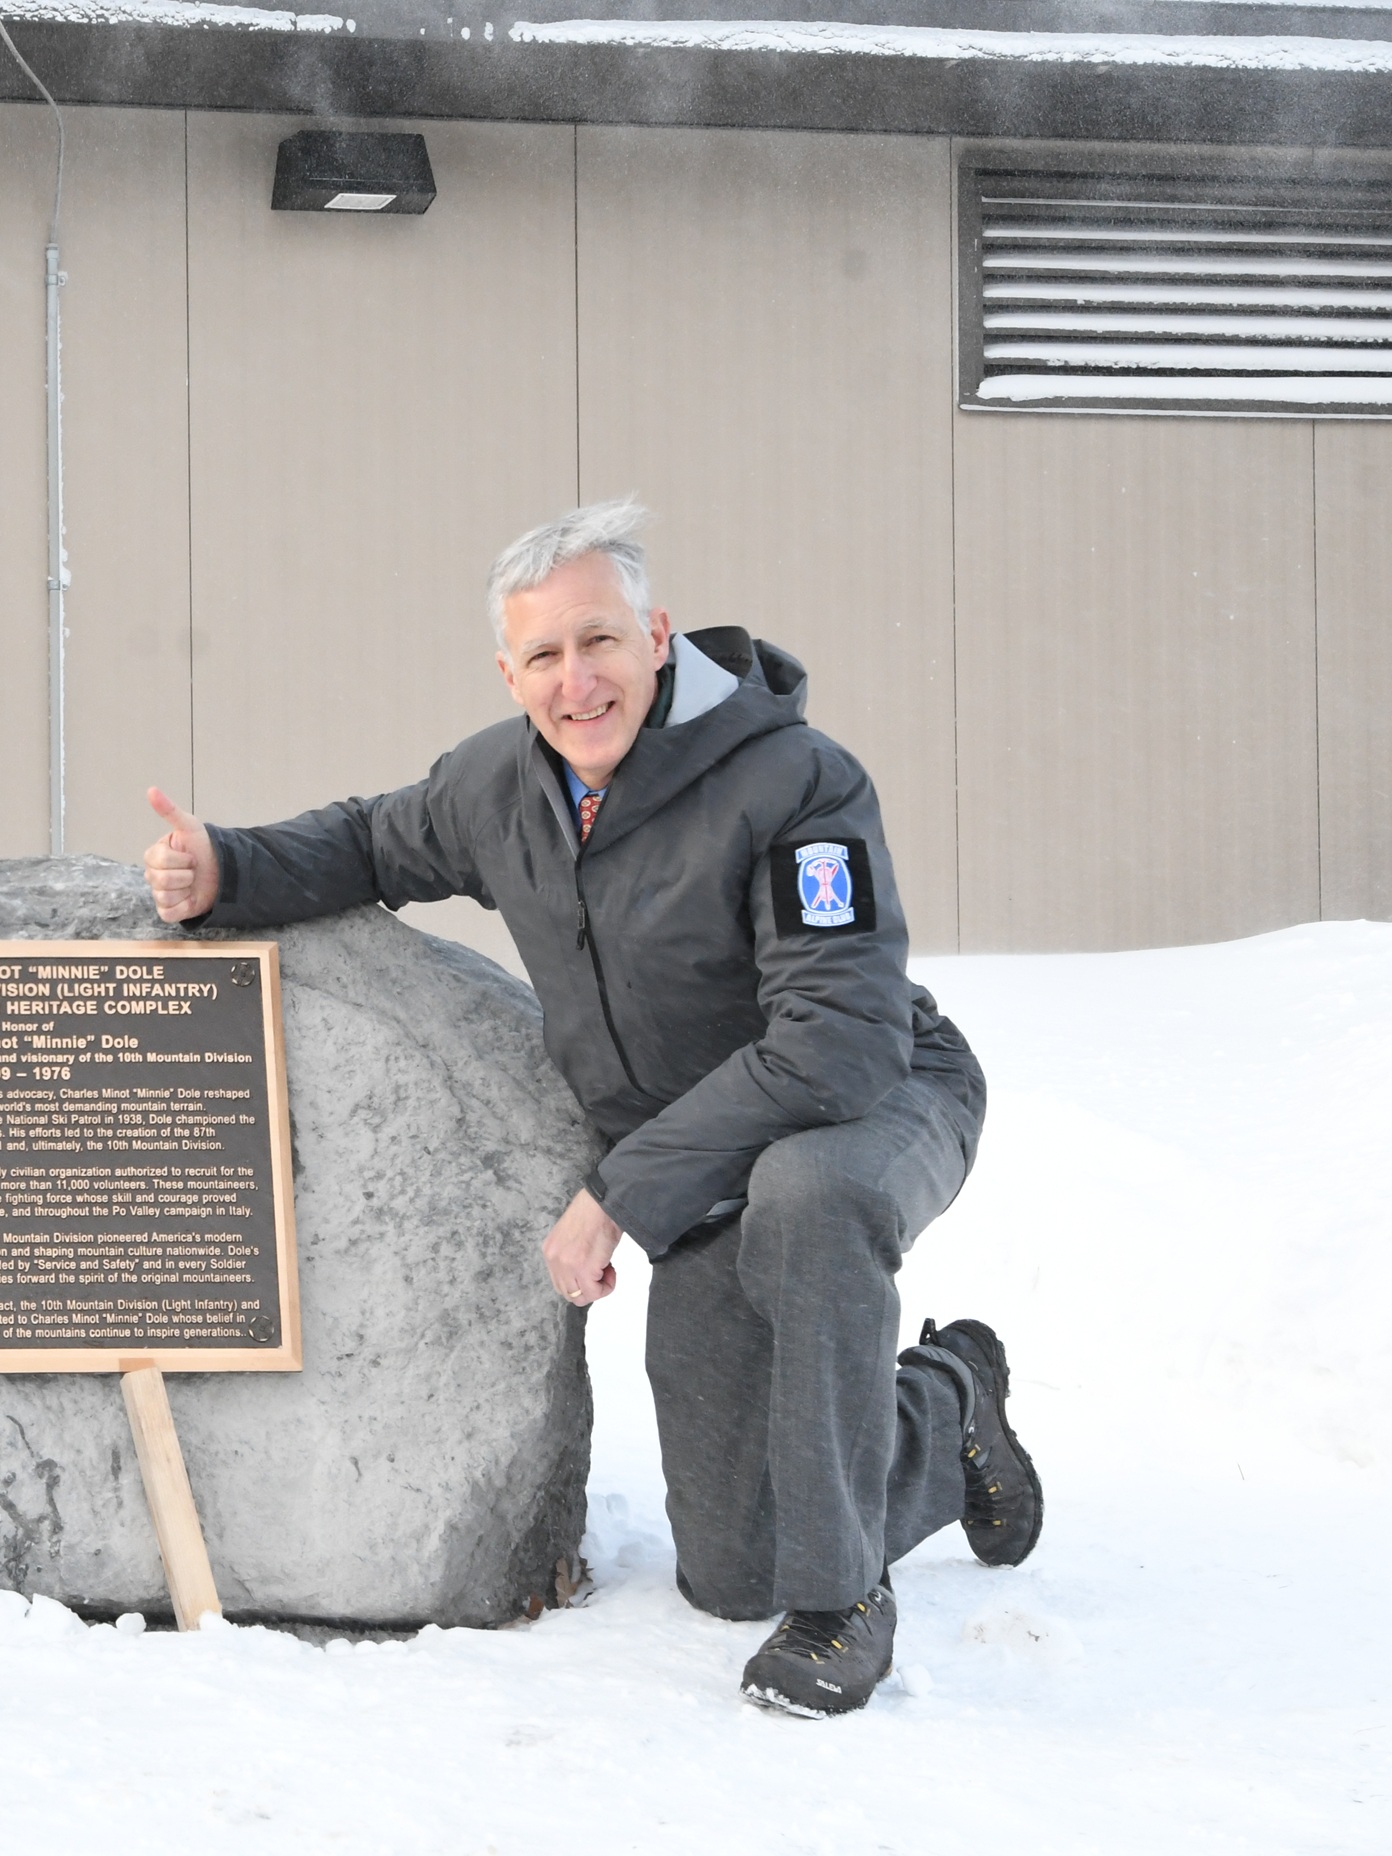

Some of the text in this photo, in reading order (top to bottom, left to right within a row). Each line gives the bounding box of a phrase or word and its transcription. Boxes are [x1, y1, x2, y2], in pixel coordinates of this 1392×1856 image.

[115, 964, 165, 980] DOLE
[56, 982, 117, 1000] (LIGHT
[122, 982, 218, 1000] INFANTRY)
[6, 1000, 98, 1015] HERITAGE
[103, 999, 192, 1015] COMPLEX
[1, 1020, 39, 1032] Honor
[41, 1020, 55, 1032] of
[100, 1034, 139, 1049] Dole
[19, 1051, 75, 1065] visionary
[78, 1051, 92, 1063] of
[93, 1051, 114, 1063] the
[116, 1051, 143, 1063] 10th
[146, 1051, 201, 1063] Mountain
[203, 1051, 253, 1063] Division
[32, 1065, 71, 1081] 1976
[6, 1088, 56, 1101] advocacy,
[59, 1087, 99, 1099] Charles
[101, 1087, 130, 1099] Minot
[176, 1087, 201, 1099] Dole
[203, 1088, 250, 1100] reshaped
[5, 1113, 49, 1125] National
[51, 1113, 68, 1125] Ski
[70, 1113, 101, 1125] Patrol
[103, 1114, 114, 1124] in
[117, 1113, 146, 1125] 1938,
[148, 1113, 173, 1124] Dole
[174, 1113, 236, 1126] championed
[238, 1113, 255, 1124] the
[5, 1139, 29, 1152] and,
[31, 1139, 83, 1153] ultimately,
[86, 1139, 103, 1151] the
[106, 1139, 129, 1150] 10th
[131, 1139, 179, 1151] Mountain
[181, 1139, 225, 1150] Division.
[9, 1166, 46, 1177] civilian
[48, 1165, 112, 1179] organization
[114, 1165, 168, 1177] authorized
[170, 1166, 182, 1176] to
[184, 1166, 218, 1177] recruit
[219, 1165, 235, 1176] for
[236, 1166, 254, 1176] the
[2, 1231, 50, 1243] Mountain
[52, 1231, 94, 1243] Division
[96, 1231, 149, 1245] pioneered
[203, 1231, 243, 1242] modern
[17, 1259, 31, 1273] by
[79, 1258, 99, 1270] and
[142, 1258, 162, 1270] and
[164, 1258, 175, 1269] in
[177, 1260, 207, 1271] every
[209, 1257, 246, 1269] Soldier
[19, 1299, 37, 1311] the
[40, 1299, 63, 1311] 10th
[66, 1299, 114, 1310] Mountain
[116, 1298, 158, 1310] Division
[161, 1298, 192, 1312] (Light
[194, 1298, 238, 1312] Infantry)
[240, 1298, 260, 1310] and
[2, 1326, 14, 1338] of
[15, 1327, 32, 1338] the
[34, 1326, 86, 1338] mountains
[88, 1327, 131, 1338] continue
[133, 1326, 144, 1337] to
[146, 1325, 180, 1339] inspire
